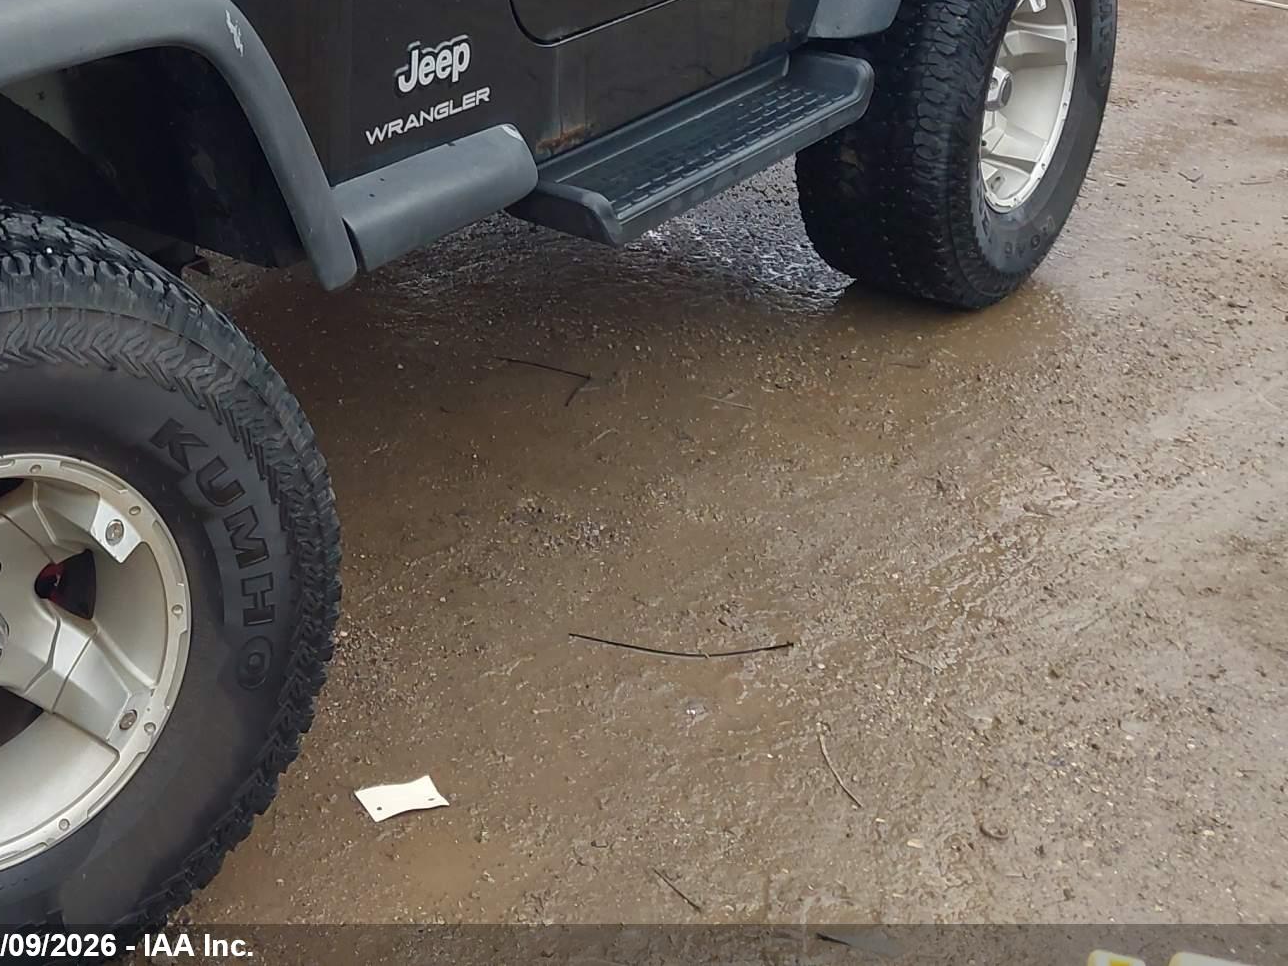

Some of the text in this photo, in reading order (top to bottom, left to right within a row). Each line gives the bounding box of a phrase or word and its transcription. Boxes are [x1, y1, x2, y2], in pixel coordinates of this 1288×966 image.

[395, 35, 471, 93] Jeep
[365, 86, 491, 145] WRANGLER
[149, 417, 276, 691] KUMHO
